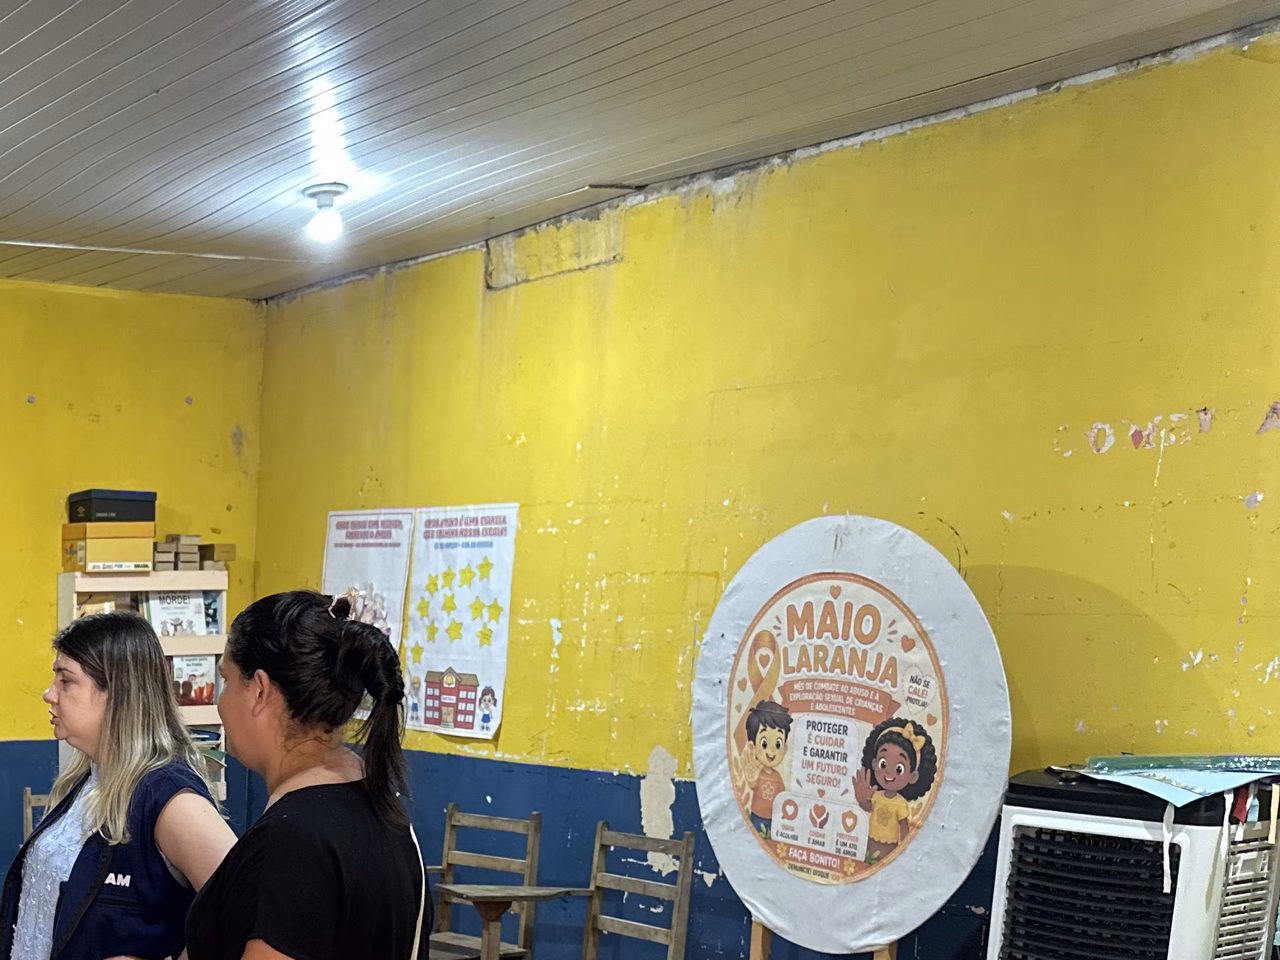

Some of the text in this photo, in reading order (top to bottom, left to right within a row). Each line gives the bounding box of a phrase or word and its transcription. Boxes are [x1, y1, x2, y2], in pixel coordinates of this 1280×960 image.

[158, 594, 191, 605] MORDE!
[786, 600, 882, 645] MAIO
[782, 644, 898, 689] LARANJA
[793, 681, 805, 691] MÊS
[805, 682, 813, 690] DE
[814, 682, 840, 692] COMBATE
[840, 684, 849, 693] AO
[849, 686, 870, 698] ABUSO
[909, 674, 930, 688] NÃO SE
[907, 685, 928, 699] CALE!
[789, 691, 884, 713] EXPLORAÇÃO SEXUAL DE CRIANÇAS
[815, 703, 856, 716] ADOLESCENTES
[806, 719, 849, 736] PROTEGER
[807, 732, 845, 748] É CUIDAR
[803, 746, 848, 763] E GARANTIR
[801, 759, 848, 776] UM FUTURO
[806, 773, 841, 789] SEGURO!
[788, 847, 841, 870] FAÇA BONITO!
